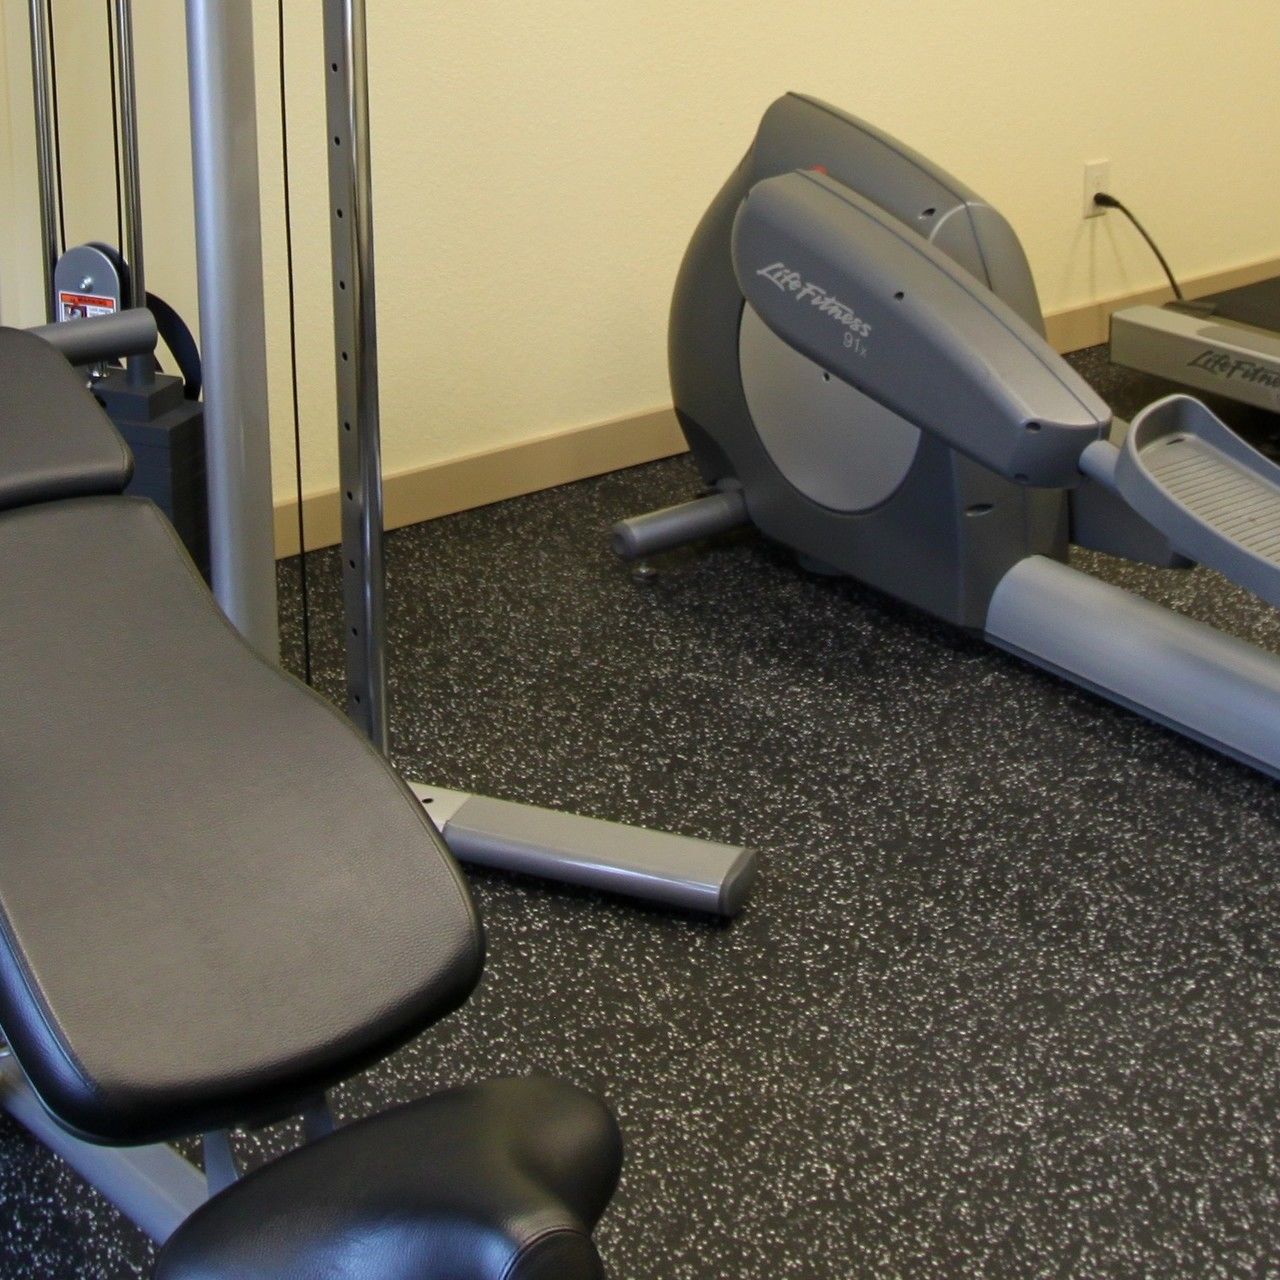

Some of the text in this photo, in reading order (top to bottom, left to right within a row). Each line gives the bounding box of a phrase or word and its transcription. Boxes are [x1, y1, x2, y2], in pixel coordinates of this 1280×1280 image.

[756, 262, 872, 337] Life Fitness
[1187, 350, 1231, 376] Life
